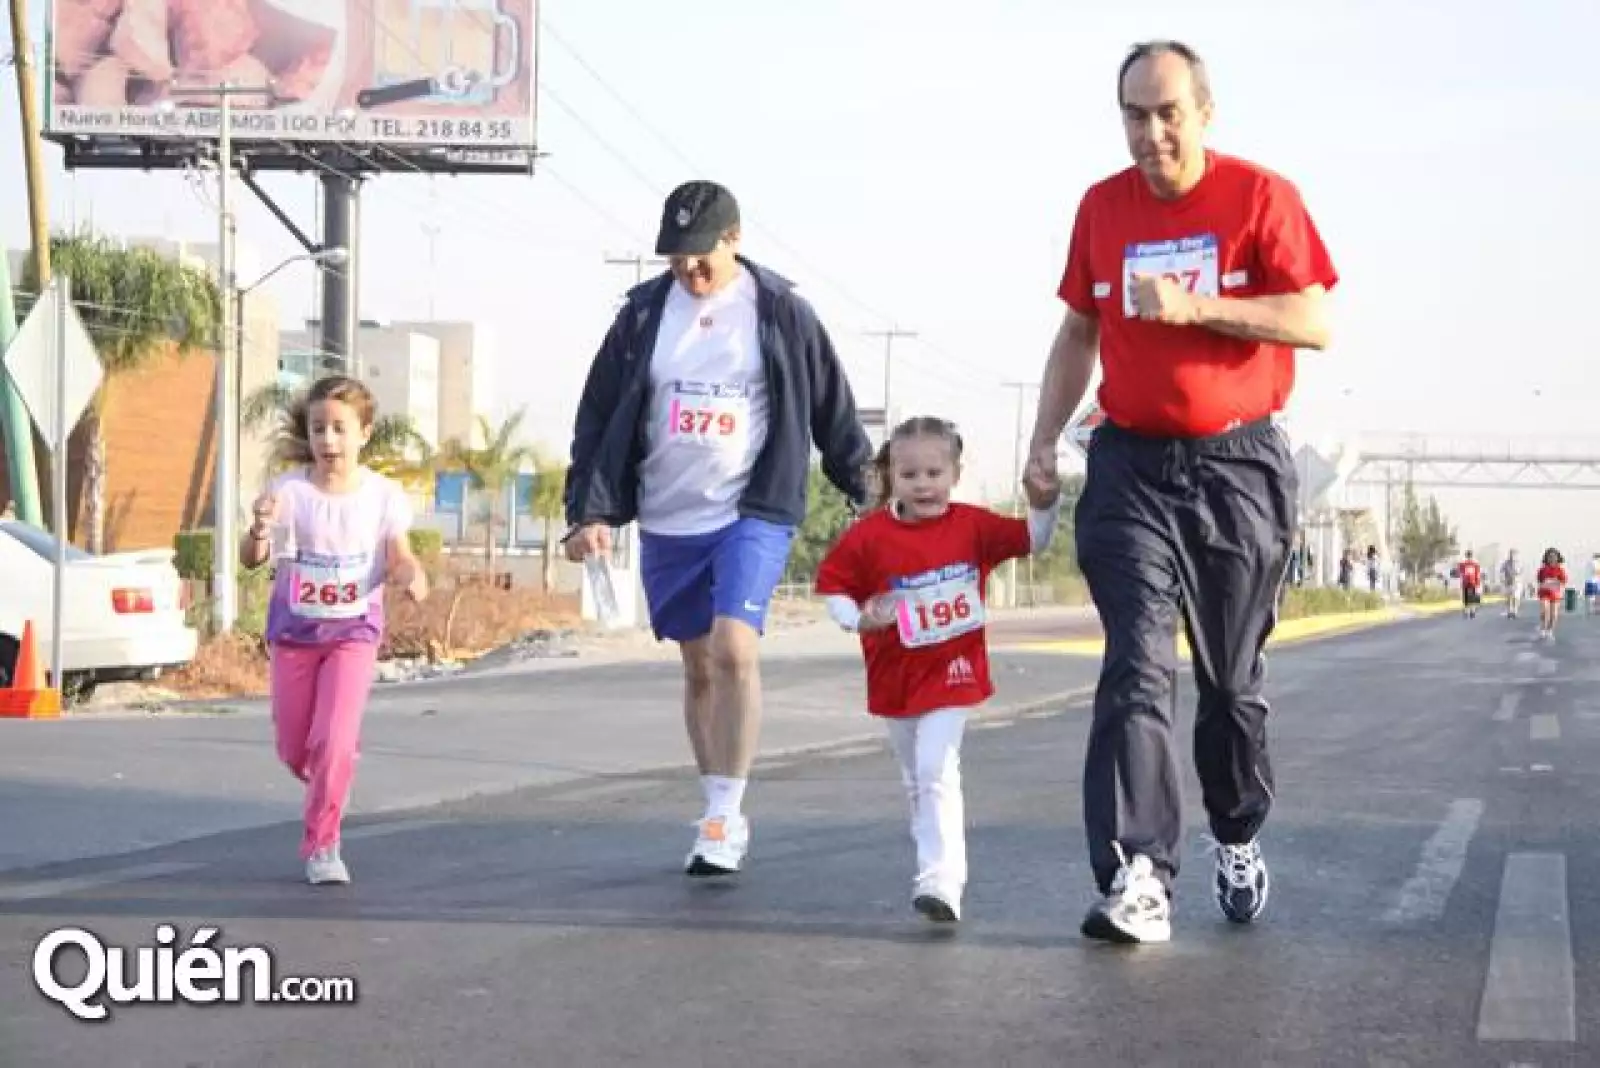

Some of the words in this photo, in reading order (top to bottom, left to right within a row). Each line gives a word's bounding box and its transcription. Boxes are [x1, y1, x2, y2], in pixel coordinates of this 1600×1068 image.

[370, 118, 411, 137] TEL.
[416, 119, 454, 138] 218
[459, 119, 483, 139] 84
[488, 119, 511, 139] 55
[679, 409, 736, 435] 379
[299, 582, 358, 606] 263
[914, 592, 971, 631] 196
